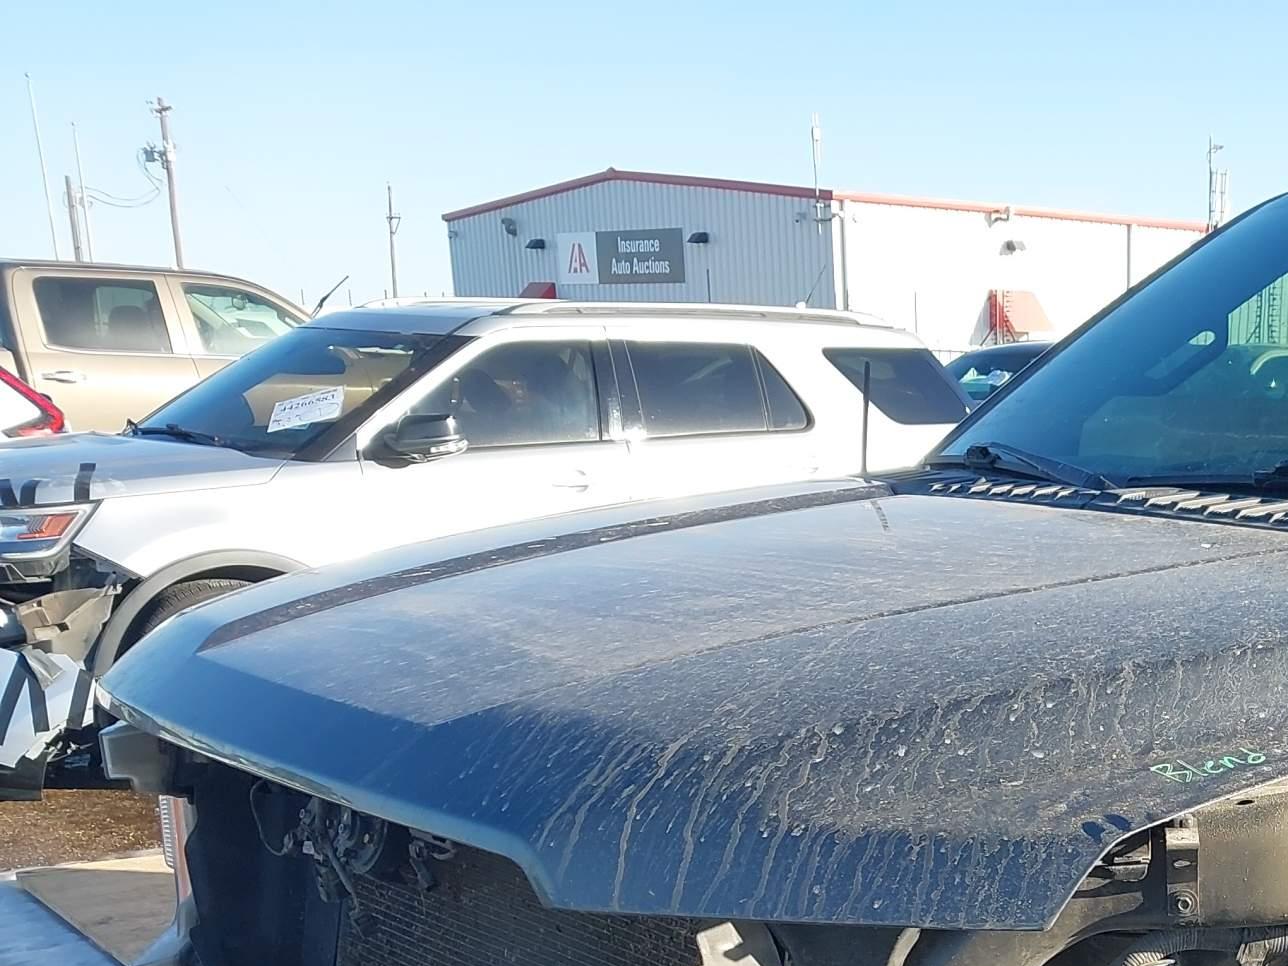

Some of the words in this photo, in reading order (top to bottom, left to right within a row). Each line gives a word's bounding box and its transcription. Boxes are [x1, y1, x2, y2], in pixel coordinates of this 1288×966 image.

[617, 236, 660, 253] Insurance
[611, 257, 631, 275] Auto
[632, 256, 670, 274] Auctions
